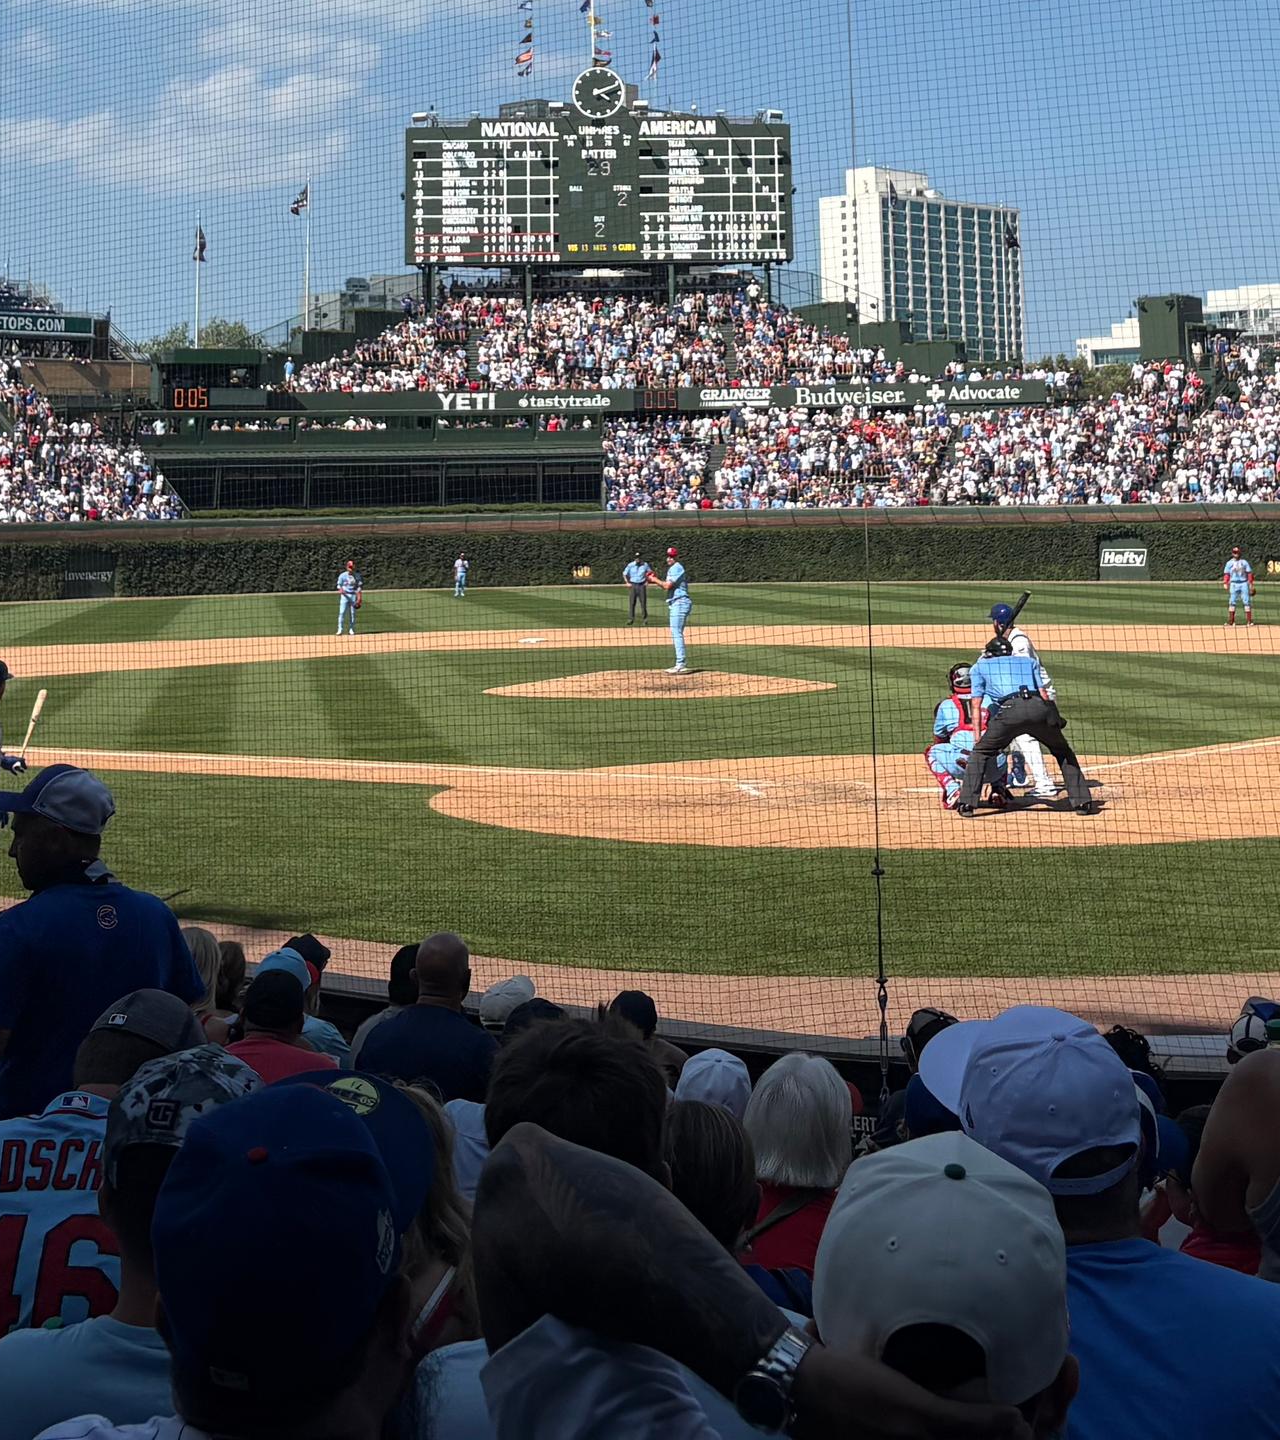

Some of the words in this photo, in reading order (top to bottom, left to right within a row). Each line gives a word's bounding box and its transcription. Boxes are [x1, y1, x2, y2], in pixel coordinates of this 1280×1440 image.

[481, 122, 559, 137] NATIONAL
[639, 120, 717, 136] AMERICAN
[587, 160, 612, 176] 29
[617, 191, 628, 206] 2
[594, 223, 605, 238] 2
[700, 389, 771, 401] GRAINGER
[948, 385, 1020, 401] Advocate
[437, 393, 495, 410] YETI
[529, 393, 611, 409] tastytrade
[1103, 551, 1144, 565] Hefty
